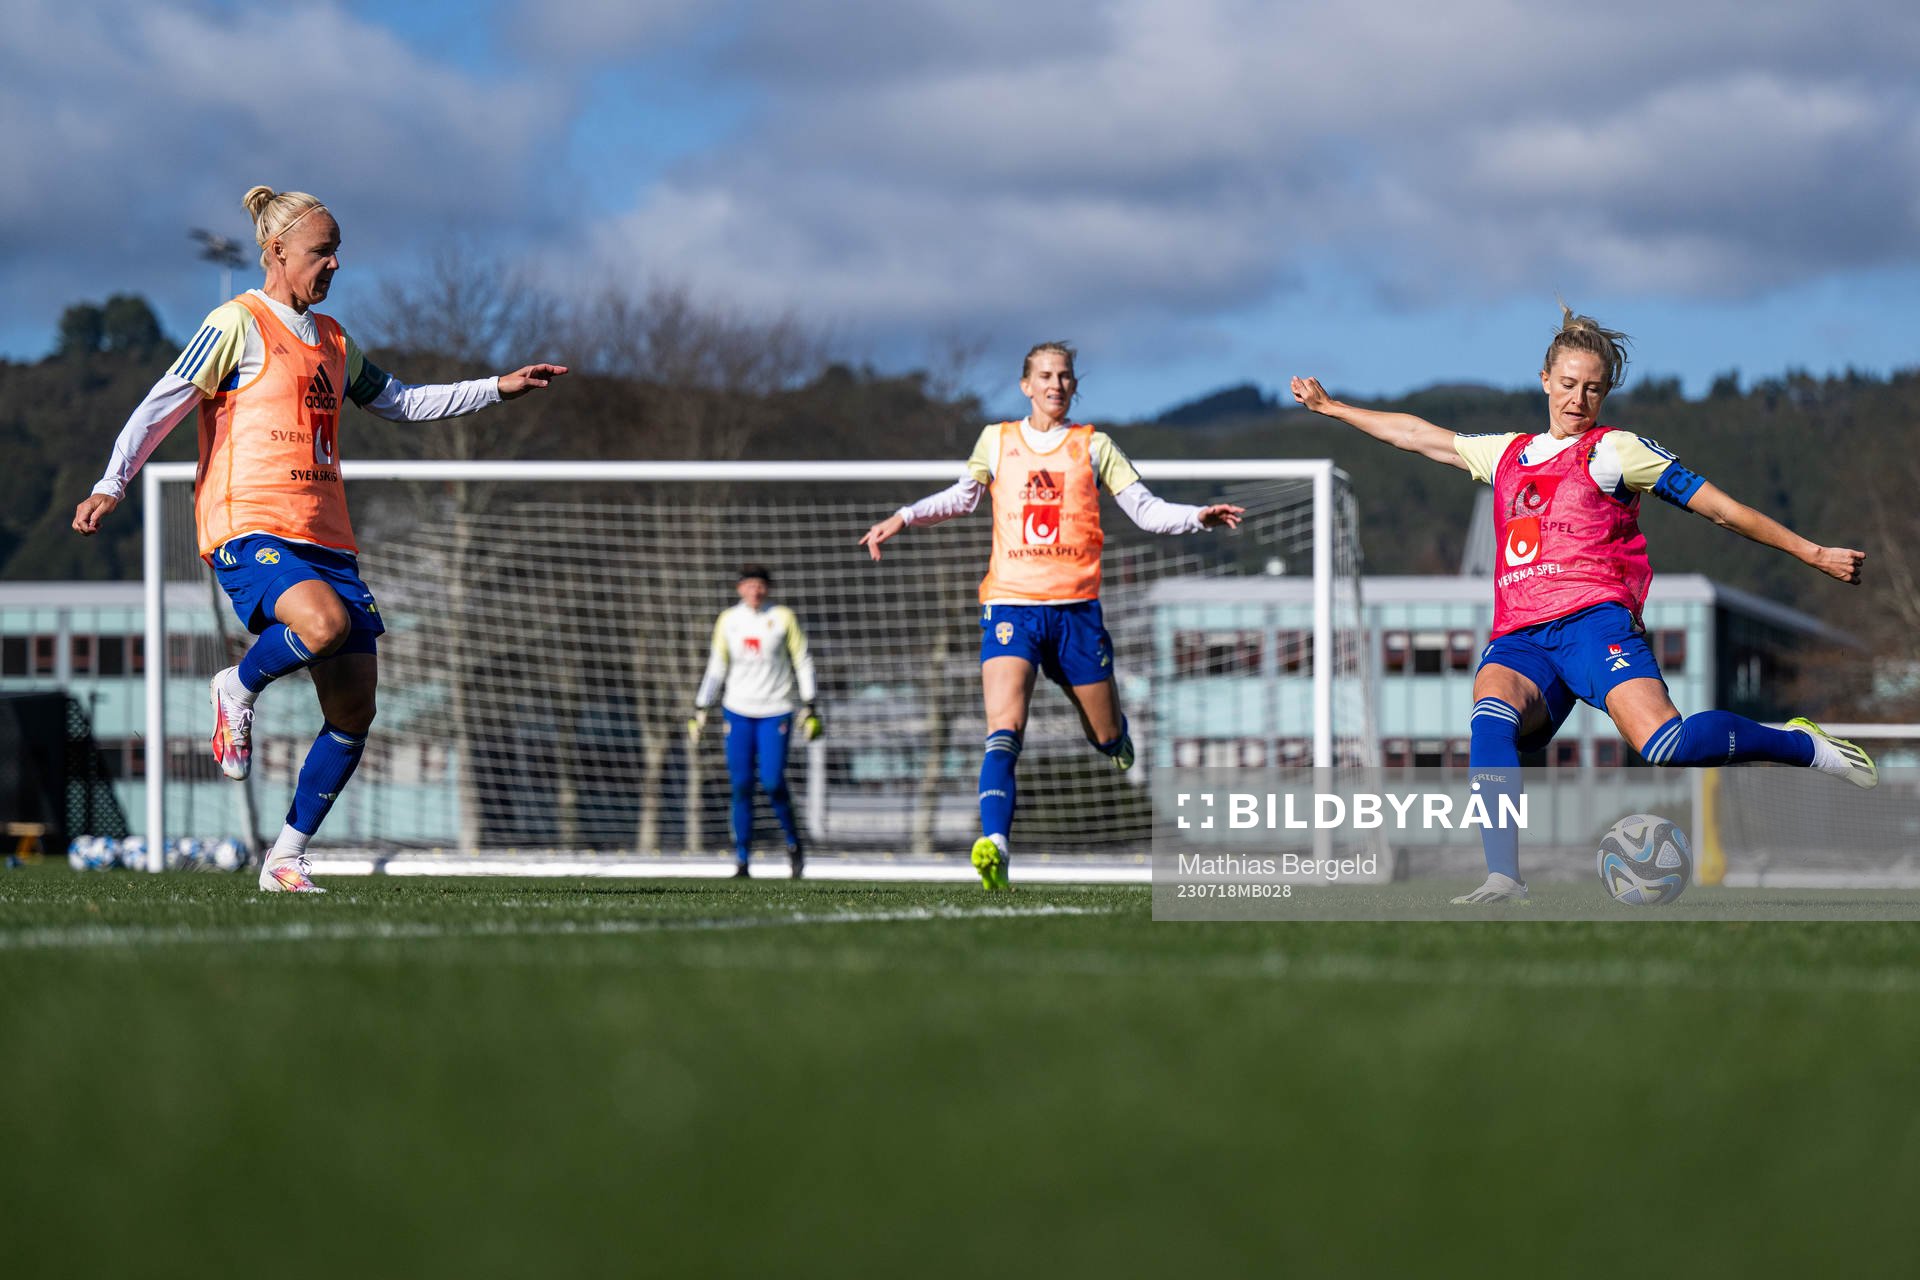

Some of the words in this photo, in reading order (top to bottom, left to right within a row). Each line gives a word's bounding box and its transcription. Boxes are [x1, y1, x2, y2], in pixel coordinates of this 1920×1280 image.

[305, 393, 337, 409] adida
[270, 430, 312, 444] SVENS
[1541, 521, 1575, 534] SPEL
[1008, 548, 1052, 558] SVENSKA
[1056, 547, 1078, 556] SPEL
[1498, 567, 1535, 588] VENSKA
[1536, 563, 1565, 576] SPEL
